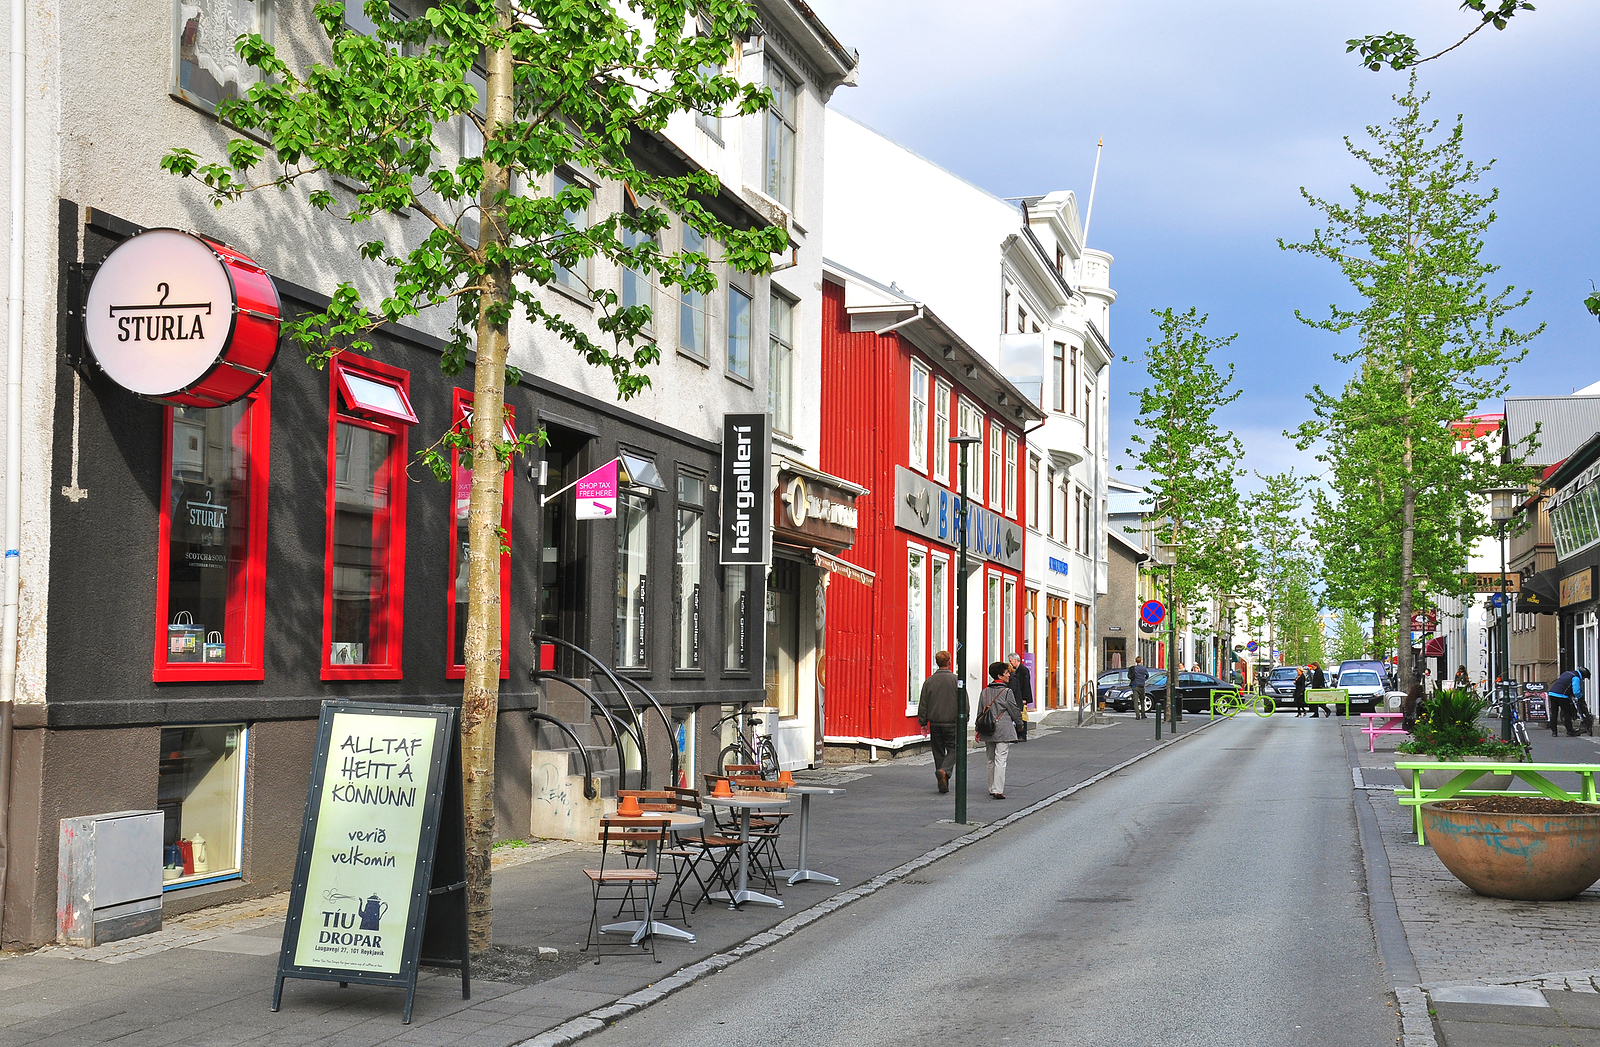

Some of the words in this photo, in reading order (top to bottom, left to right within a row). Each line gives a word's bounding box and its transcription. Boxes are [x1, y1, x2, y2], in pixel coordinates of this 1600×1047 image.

[117, 313, 205, 342] STURLA
[731, 425, 755, 553] hárgallerí
[190, 508, 225, 528] STURLA
[340, 735, 422, 756] ALLTAF
[341, 756, 397, 780] HEITT
[398, 758, 413, 782] Á
[332, 782, 416, 807] KÖNNUNNI
[348, 828, 386, 843] verið
[331, 845, 396, 867] velkomin
[322, 909, 356, 929] TÍU
[319, 931, 382, 948] DROPAR
